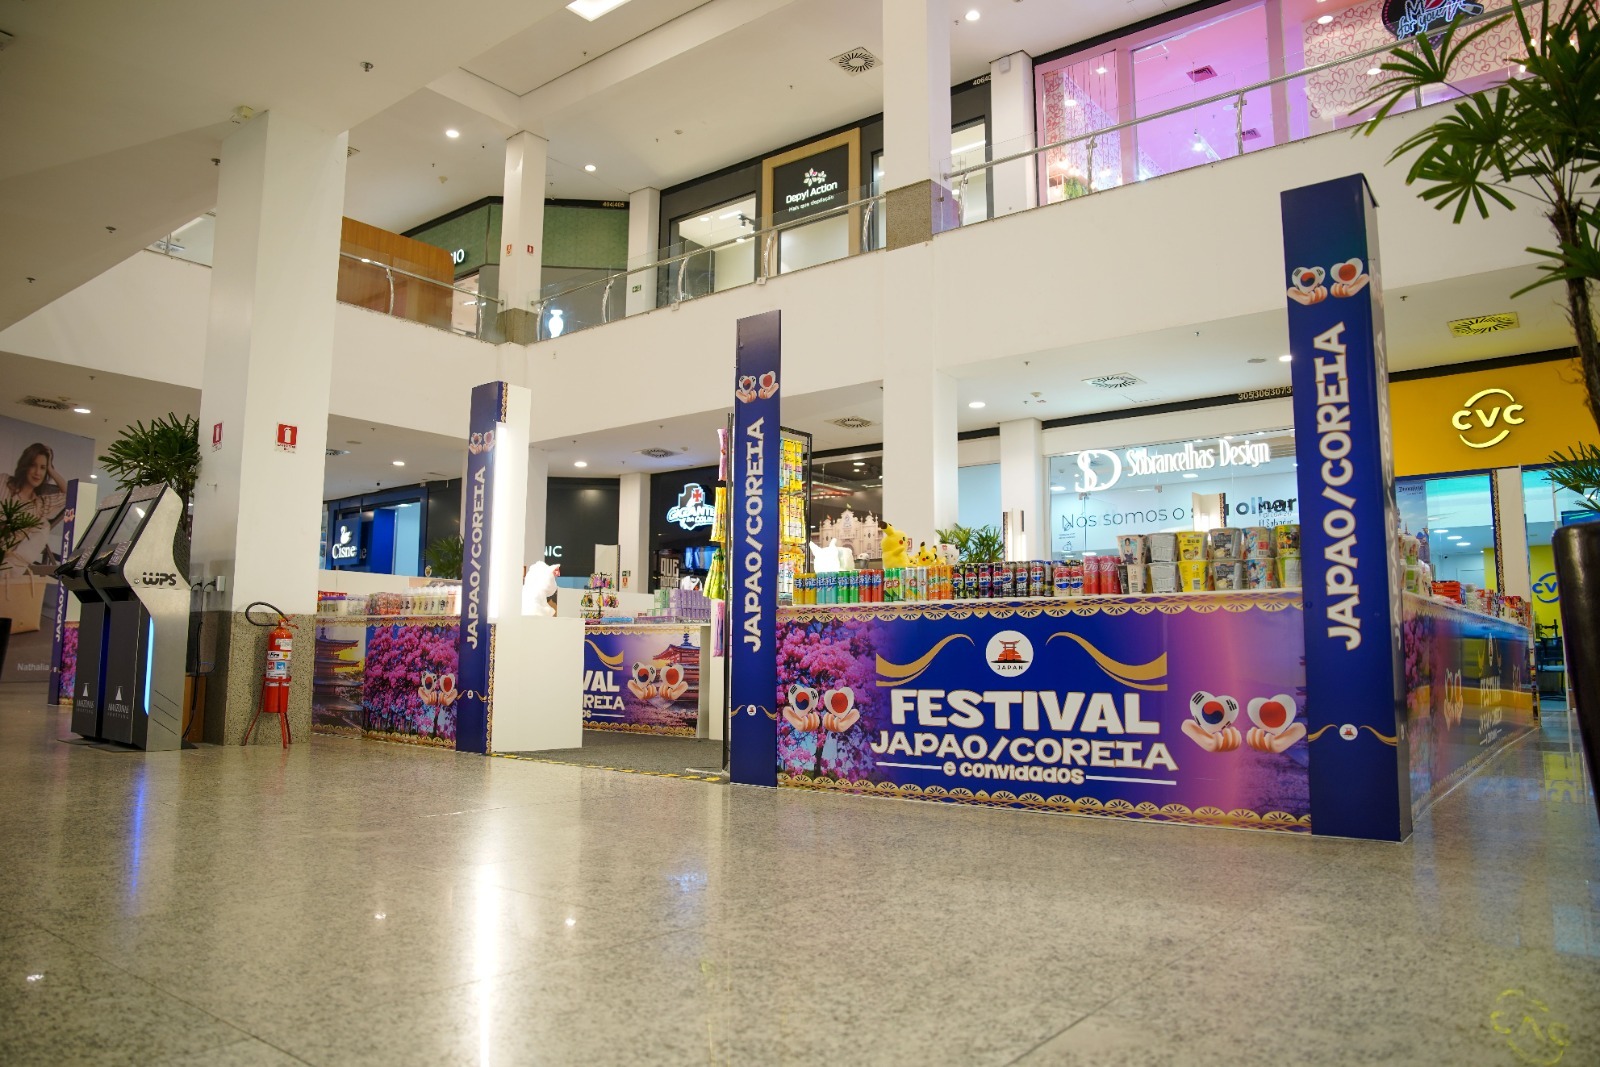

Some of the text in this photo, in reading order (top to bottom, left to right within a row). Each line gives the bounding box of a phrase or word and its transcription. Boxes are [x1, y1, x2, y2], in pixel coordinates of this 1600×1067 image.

[785, 182, 838, 204] Depyl Action
[1451, 403, 1525, 430] CVC
[1125, 438, 1271, 477] Sobrancelhas Design
[1313, 321, 1362, 651] JAPAO/COREIA
[743, 416, 765, 653] JAPAO/COREIA
[1103, 508, 1168, 526] somos
[1172, 507, 1185, 521] o
[332, 543, 357, 559] Cisne
[466, 465, 486, 650] JAPAO/COREIA
[890, 688, 1161, 735] FESTIVAL
[870, 730, 1179, 771] JAPAO/COREIA
[943, 761, 1085, 785] e convidados
